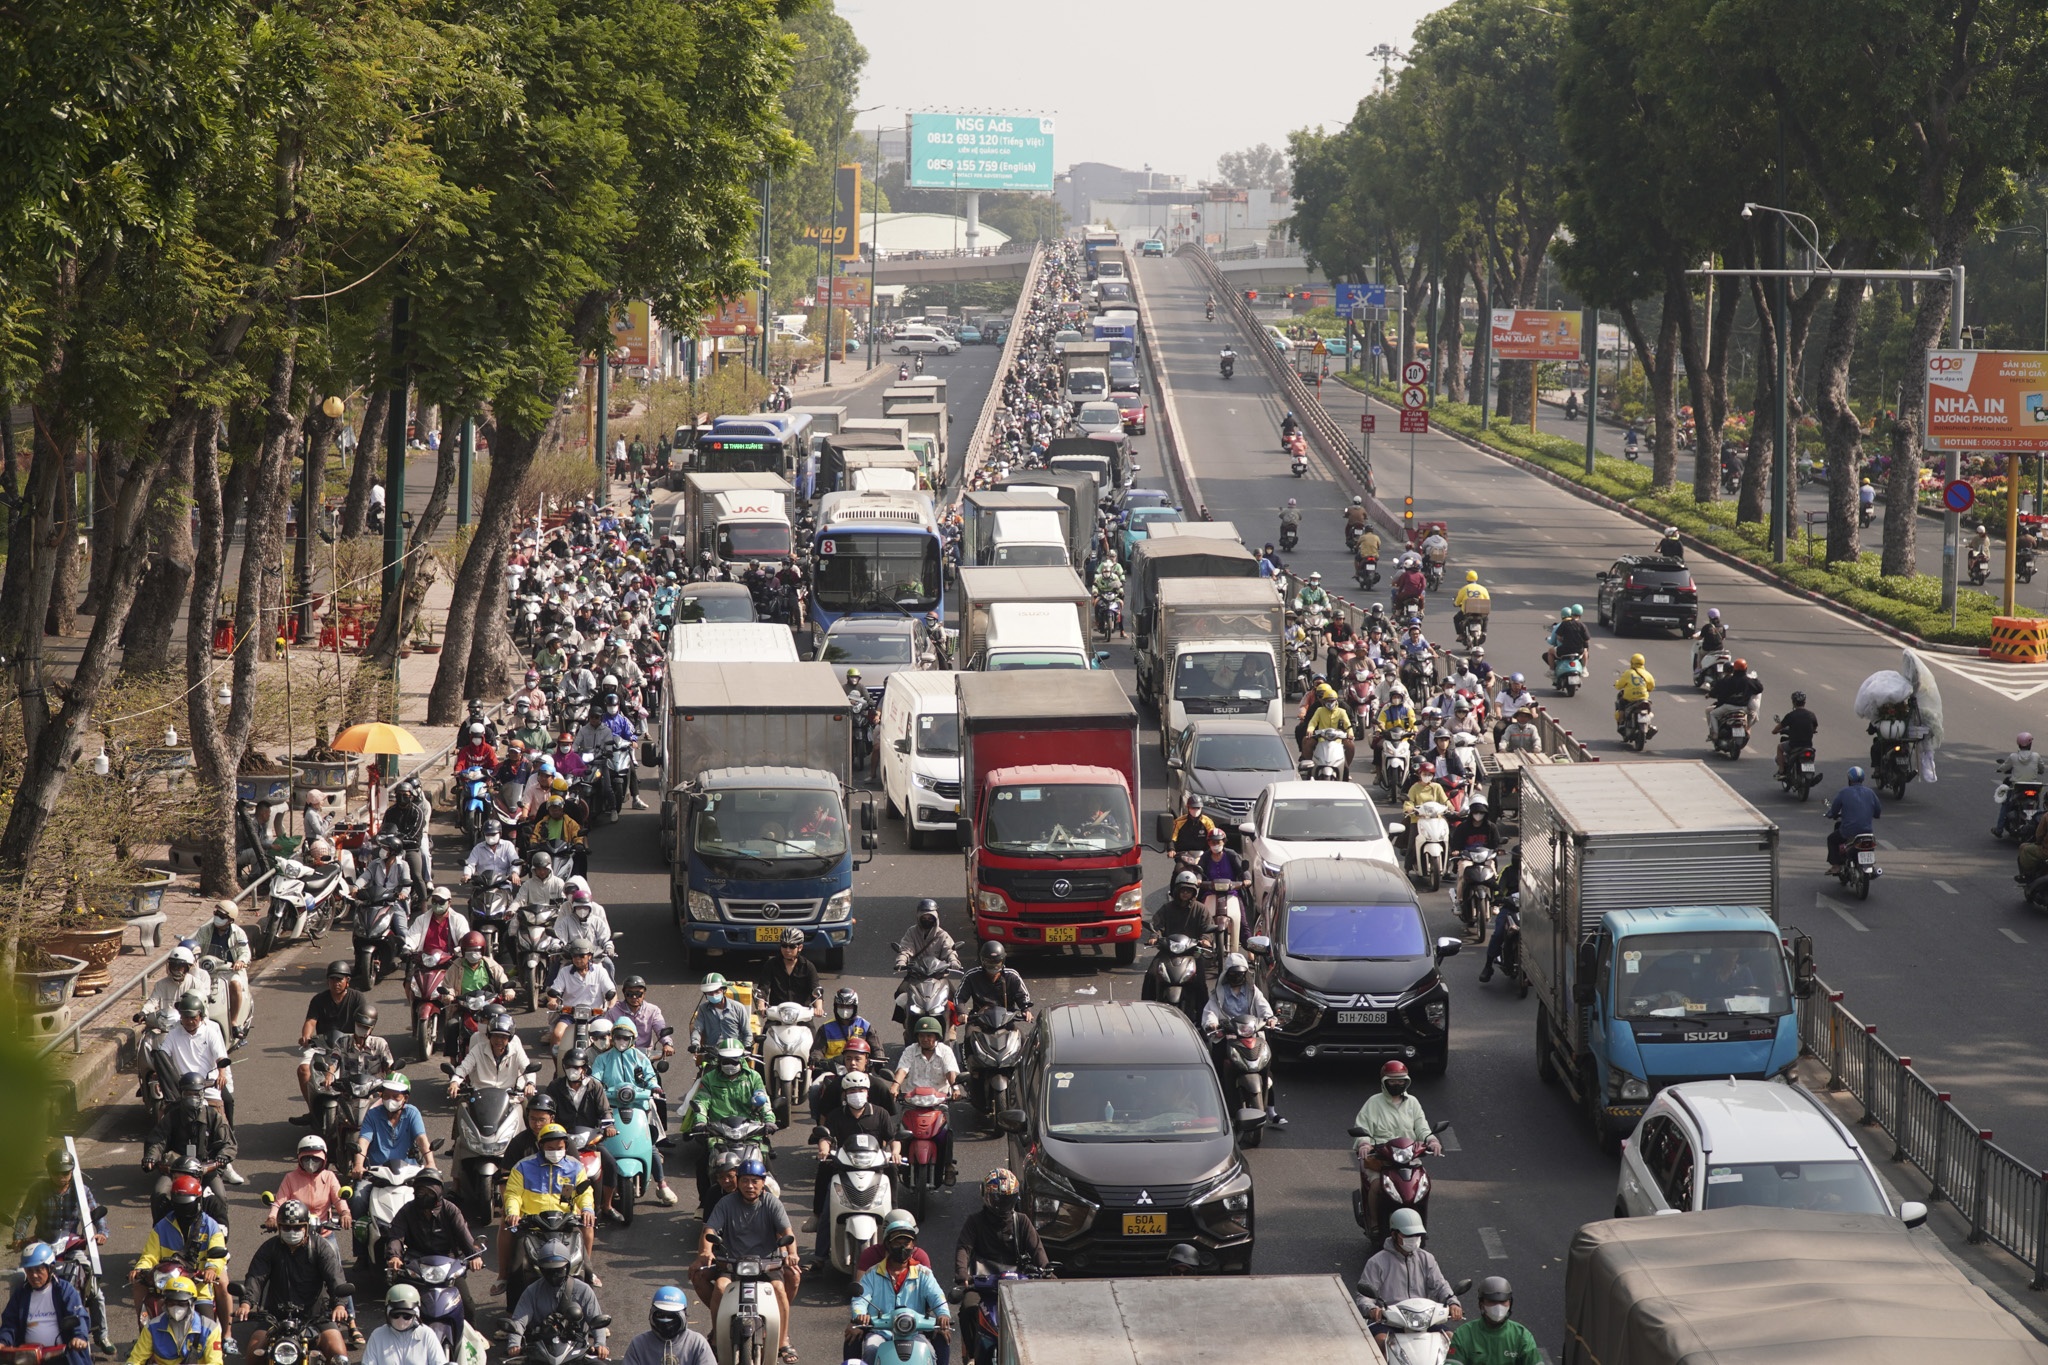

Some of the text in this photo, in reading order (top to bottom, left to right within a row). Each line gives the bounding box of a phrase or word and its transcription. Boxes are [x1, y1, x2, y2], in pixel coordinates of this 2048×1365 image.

[956, 118, 1014, 132] NSG Ads
[927, 133, 954, 144] 0812
[956, 134, 977, 145] 693
[979, 134, 999, 145] 120
[927, 159, 1036, 173] 0859 155 759 (English)
[1494, 333, 1536, 343] SẢN XUẤT
[1930, 355, 1963, 375] dpa
[2002, 360, 2042, 369] SẢN XUẤT
[2018, 369, 2027, 377] BÌ
[1934, 394, 2005, 414] NHÀ IN
[1933, 414, 2008, 424] DƯƠNG PHONG
[1944, 439, 1980, 447] HOTLINE:
[732, 506, 770, 514] JAC
[824, 541, 834, 553] 8
[1466, 588, 1481, 598] be
[765, 927, 779, 935] 51D
[1048, 934, 1073, 942] 561.25
[1684, 1031, 1729, 1042] ISUZU
[557, 1174, 571, 1186] be
[1135, 1215, 1155, 1225] 60A
[1127, 1225, 1163, 1235] 634.44
